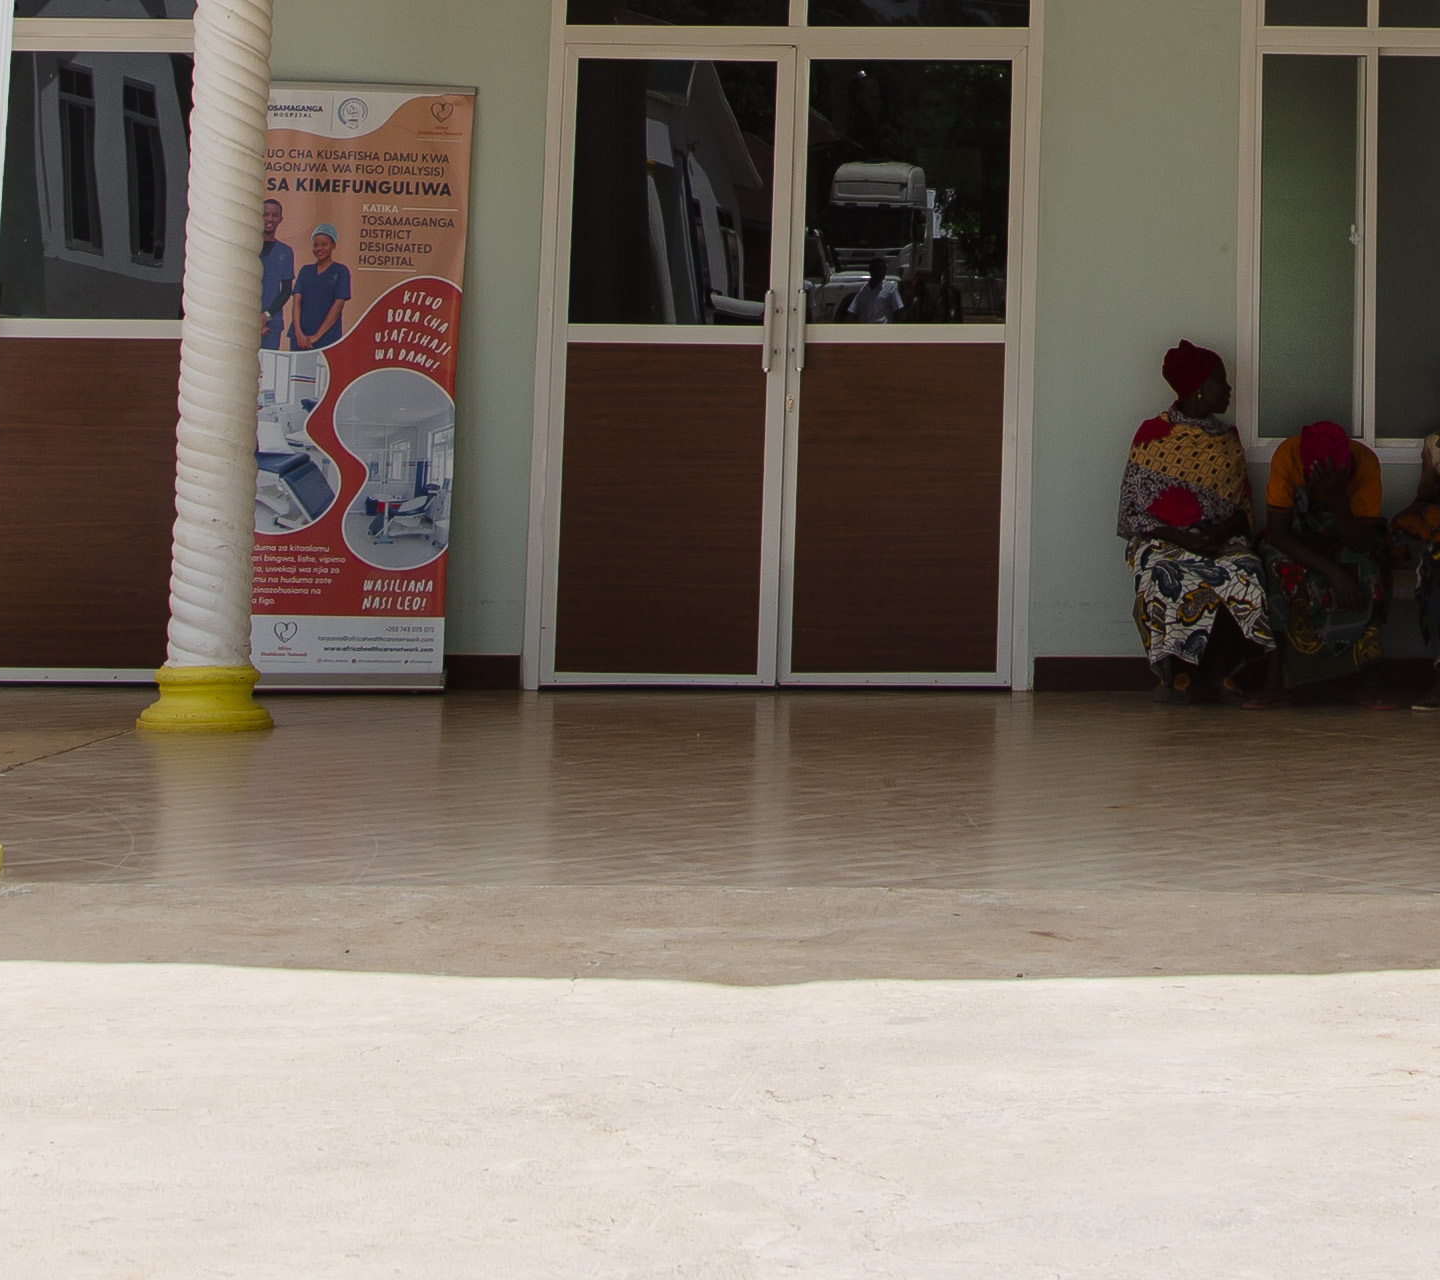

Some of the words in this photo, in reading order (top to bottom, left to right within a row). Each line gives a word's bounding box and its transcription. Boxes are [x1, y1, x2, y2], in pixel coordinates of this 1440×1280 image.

[267, 104, 323, 113] OSAMAGANGA
[288, 148, 313, 159] CHA
[317, 149, 380, 162] KUSAFISHA
[383, 151, 418, 163] DAMU
[421, 153, 449, 164] KWA
[332, 163, 352, 174] WA
[355, 164, 384, 175] FIGO
[387, 165, 445, 178] (DIALYSIS)
[296, 178, 452, 196] KIMEFUNGULIWA
[362, 203, 399, 214] KATIKA
[361, 214, 455, 228] TOSAMAGANGA
[360, 228, 412, 240] DISTRICT
[359, 241, 433, 254] DESIGNATED
[358, 255, 414, 267] HOSPITAL
[402, 290, 443, 310] KITUO
[387, 308, 420, 323] BORA
[423, 314, 449, 334] CHA
[375, 327, 452, 356] USAFISHAJI
[375, 347, 394, 360] WA
[398, 348, 440, 372] DAMU!
[251, 554, 263, 562] ari
[363, 579, 433, 593] WASILIANA
[361, 594, 392, 610] NASI
[396, 596, 427, 611] LEO!
